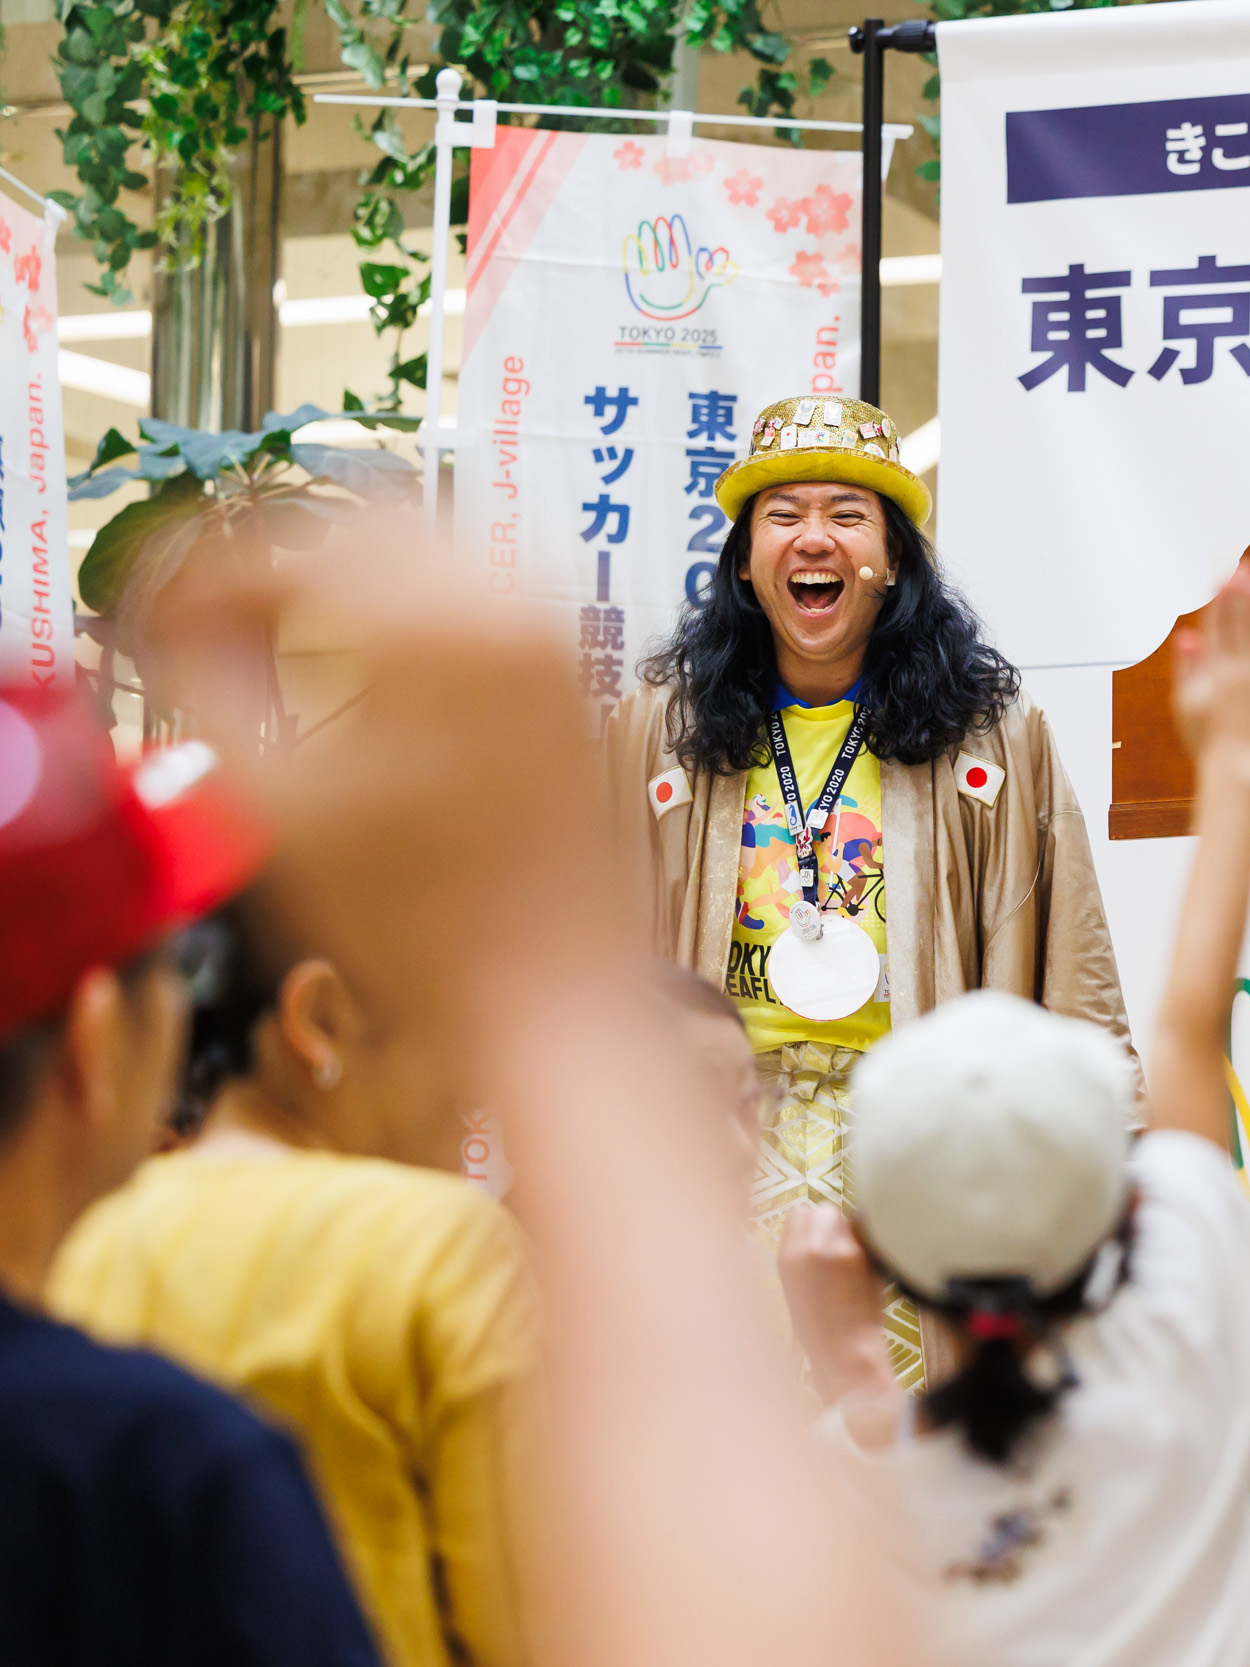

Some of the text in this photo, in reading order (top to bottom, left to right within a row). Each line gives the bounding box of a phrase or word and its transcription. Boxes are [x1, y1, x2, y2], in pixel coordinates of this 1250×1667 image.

[618, 325, 719, 345] TOKYO 2025
[811, 315, 843, 393] pan.
[488, 355, 530, 595] CER, J-village
[684, 391, 738, 610] 東京20
[28, 372, 58, 689] KUSHIMA, Japan.
[577, 385, 639, 735] サッカー競技
[780, 765, 797, 792] 2020
[826, 768, 846, 796] 2020
[728, 940, 772, 978] OKY
[724, 973, 784, 1006] EAFL
